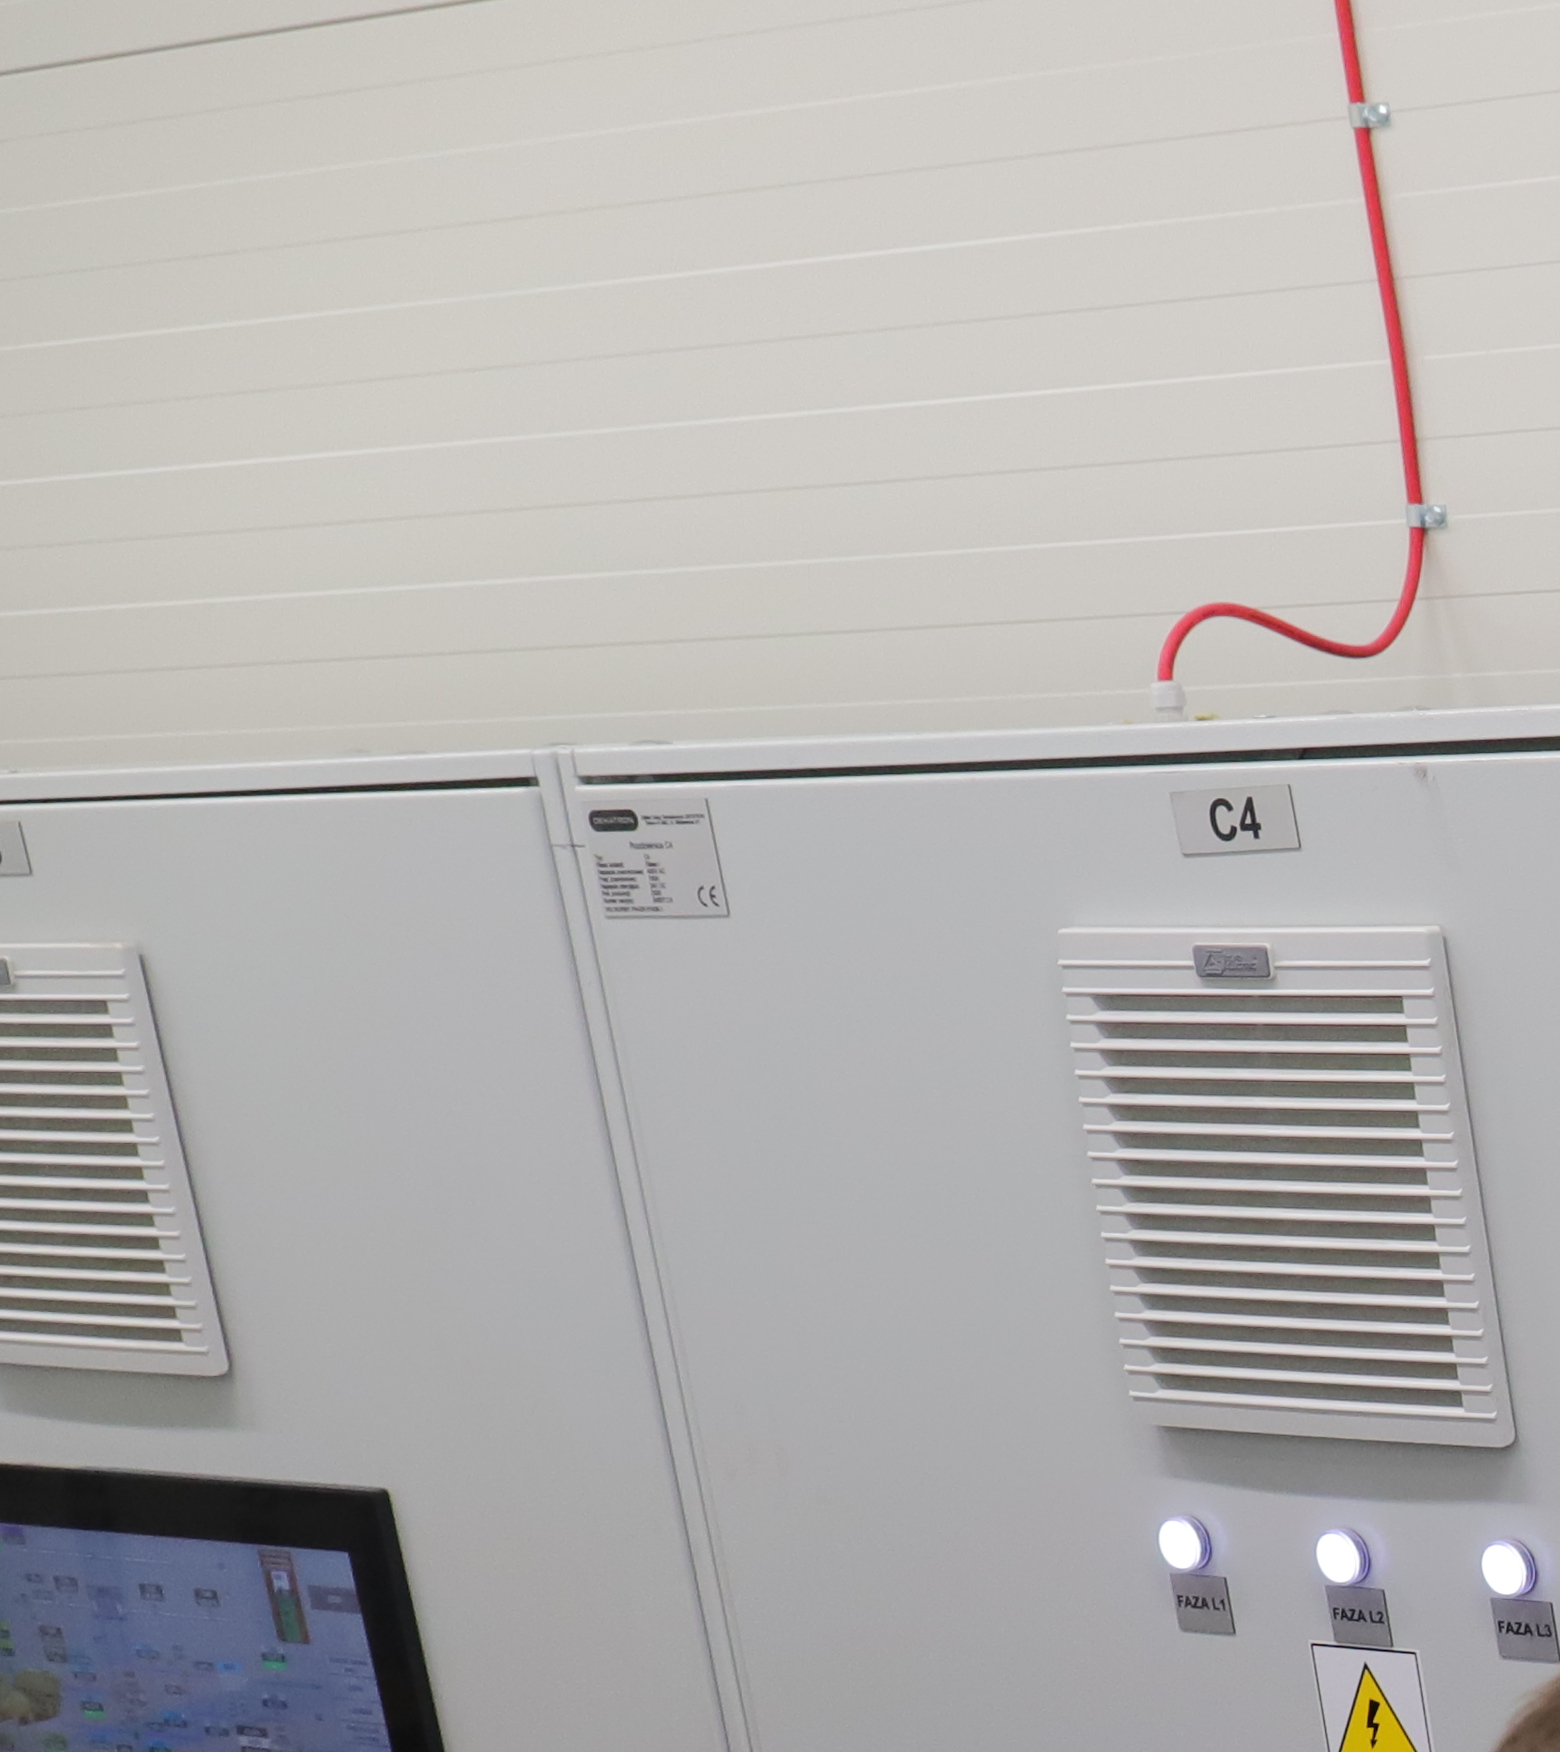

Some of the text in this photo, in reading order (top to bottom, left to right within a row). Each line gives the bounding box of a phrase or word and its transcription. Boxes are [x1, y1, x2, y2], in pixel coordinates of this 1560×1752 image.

[1208, 796, 1263, 843] C4
[1177, 1595, 1226, 1612] FAZA L1
[1332, 1606, 1386, 1625] FAZA L2
[1497, 1620, 1553, 1638] FAZA L3
